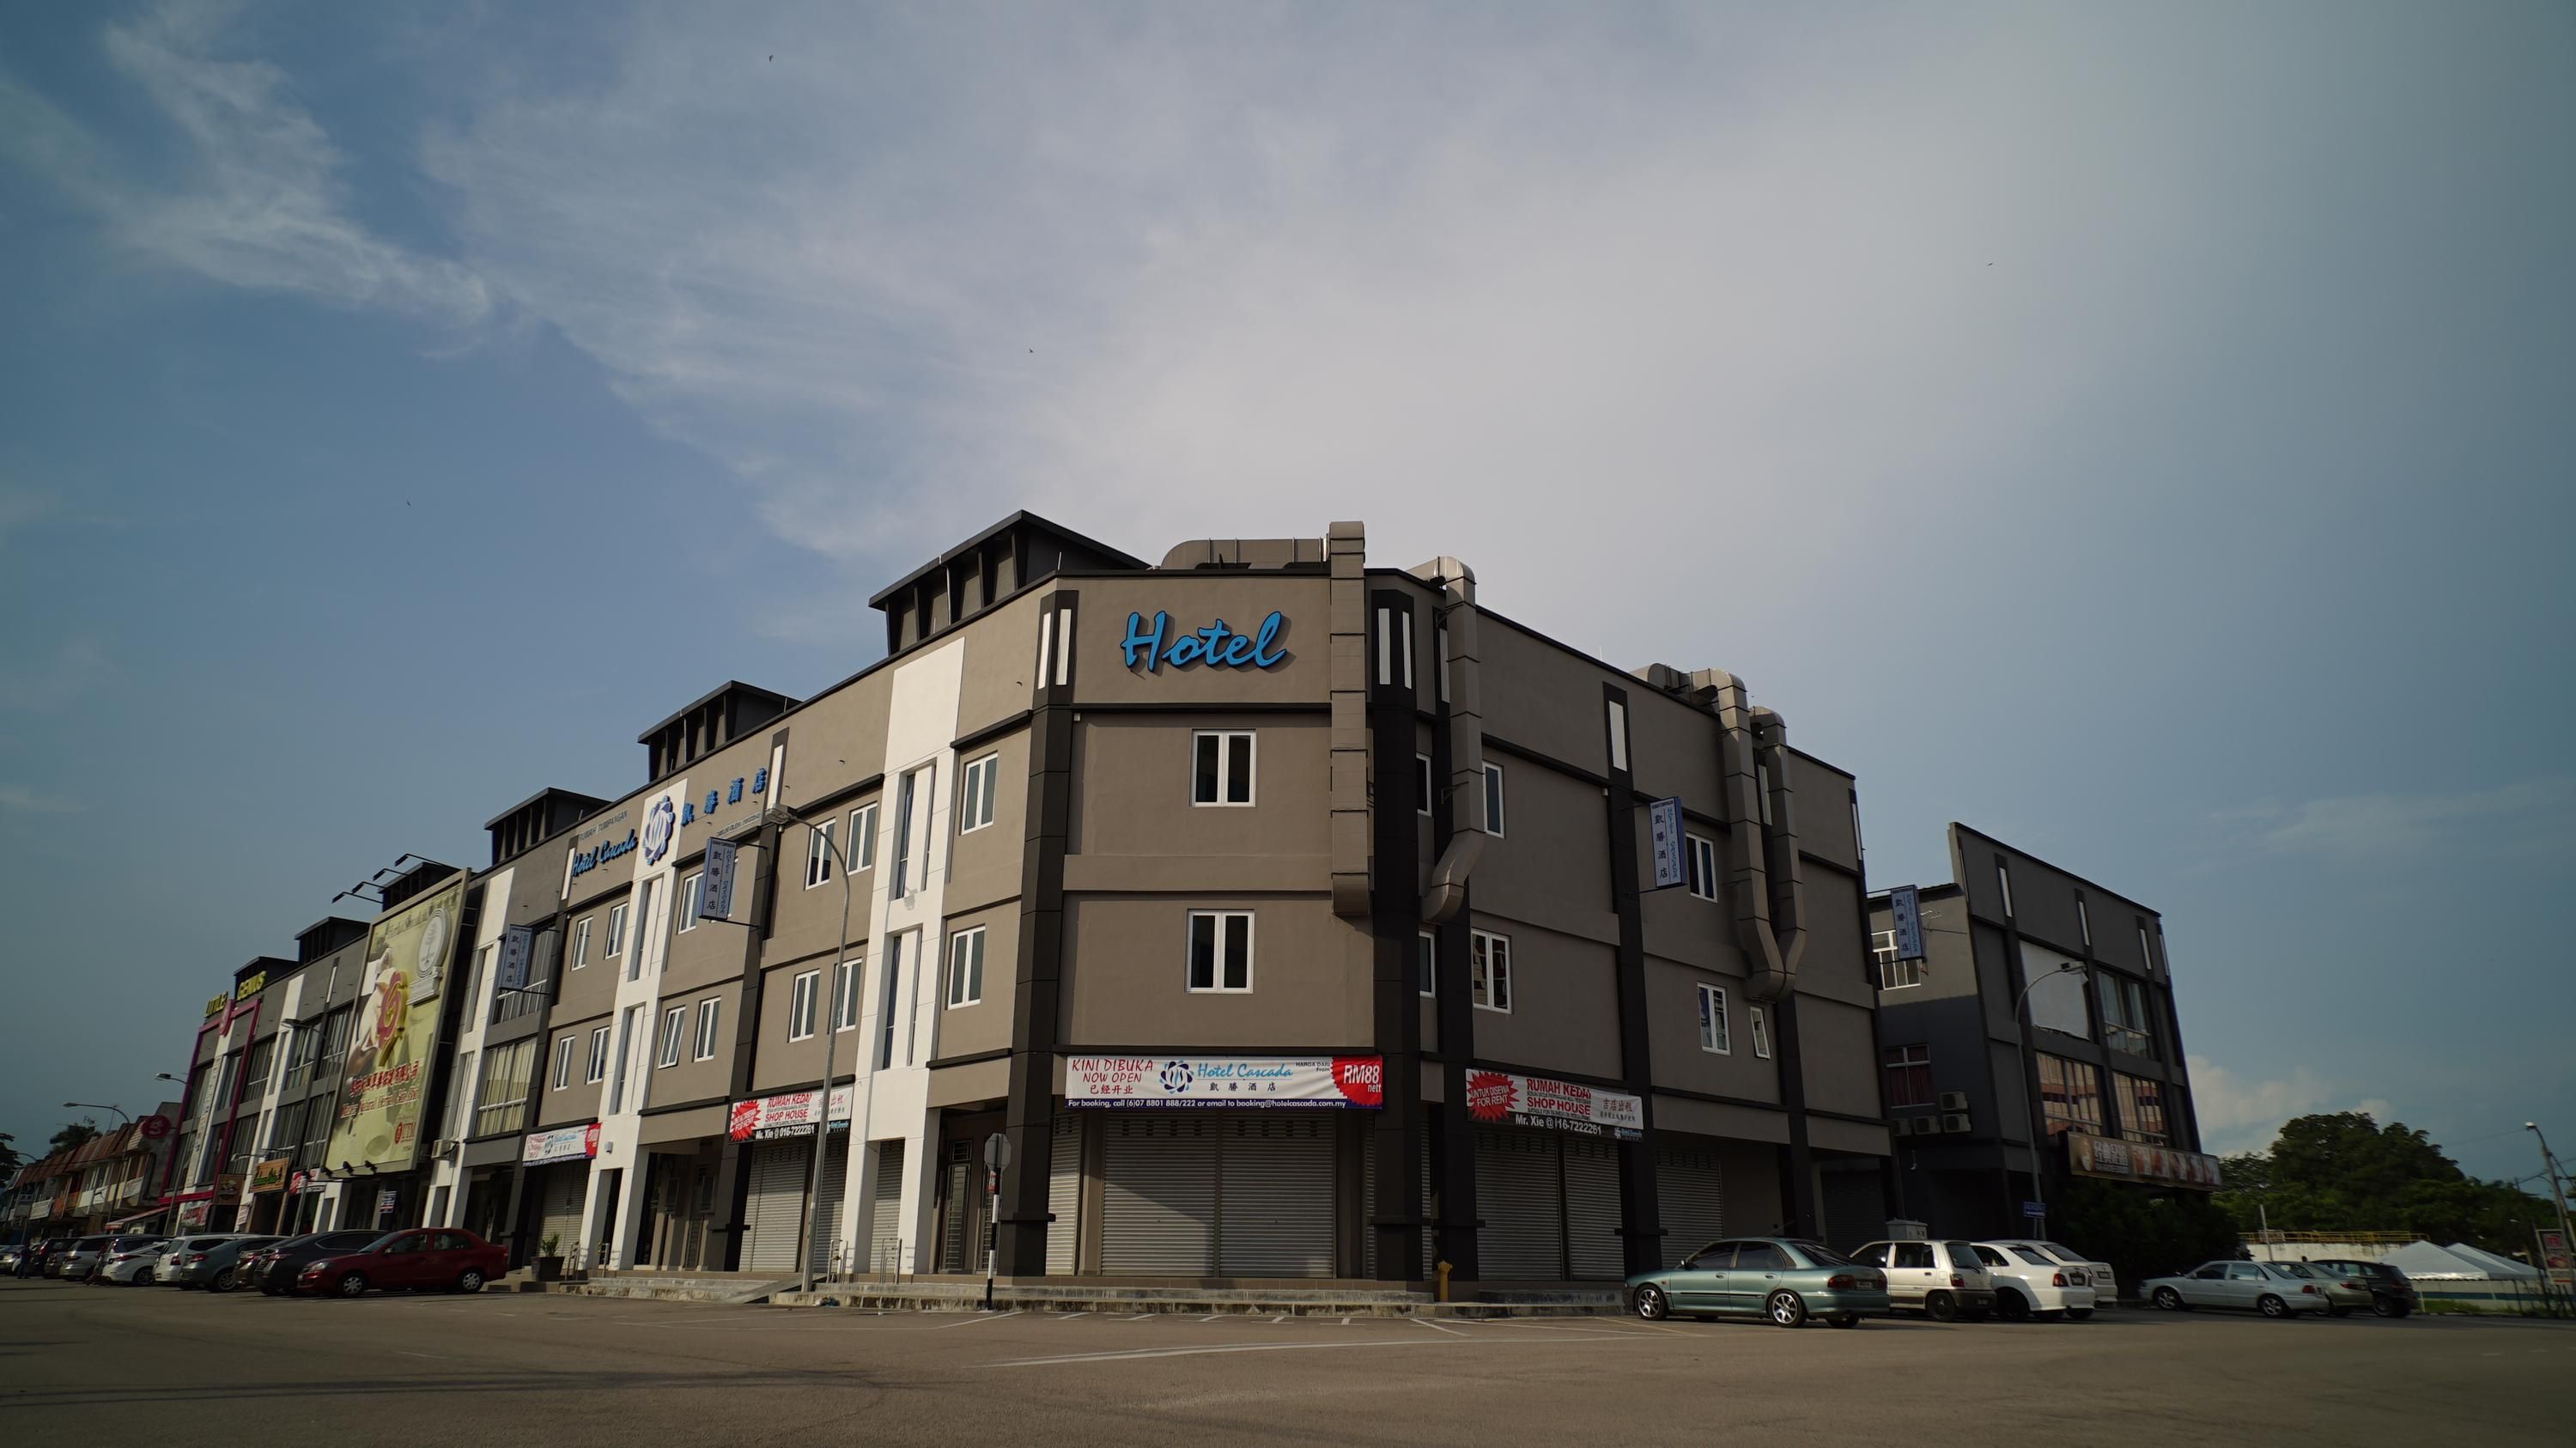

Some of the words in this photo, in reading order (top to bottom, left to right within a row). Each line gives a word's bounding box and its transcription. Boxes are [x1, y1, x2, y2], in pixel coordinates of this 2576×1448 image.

[1121, 611, 1287, 672] Hotel
[572, 846, 599, 877] Hotel
[598, 829, 639, 864] Cascada
[236, 970, 267, 1001] GENIUS
[1072, 1059, 1100, 1071] KINI
[1104, 1059, 1153, 1071] DIBUKA
[1198, 1063, 1236, 1079] Hotel
[1236, 1063, 1293, 1078] Cascada
[1083, 1072, 1109, 1083] NOW
[1112, 1072, 1142, 1083] OPEN
[1343, 1064, 1380, 1085] RM88
[1367, 1084, 1382, 1092] nett
[1488, 1086, 1510, 1097] DISEWA
[1526, 1078, 1561, 1094] RUMAH
[767, 1095, 791, 1109] RUMAH
[1081, 1099, 1111, 1108] booking,
[1127, 1099, 1145, 1108] (6)07
[1236, 1099, 1346, 1109] booking@hotelcascada.com.my
[1476, 1097, 1492, 1108] FOR
[1491, 1094, 1509, 1106] RENT
[1527, 1096, 1556, 1109] SHOP
[1557, 1099, 1591, 1116] HOUSE
[765, 1111, 785, 1123] SHOP
[785, 1109, 808, 1121] HOUSE
[1516, 1114, 1528, 1126] Mr.
[1530, 1115, 1545, 1128] Xie
[1546, 1116, 1554, 1129] @
